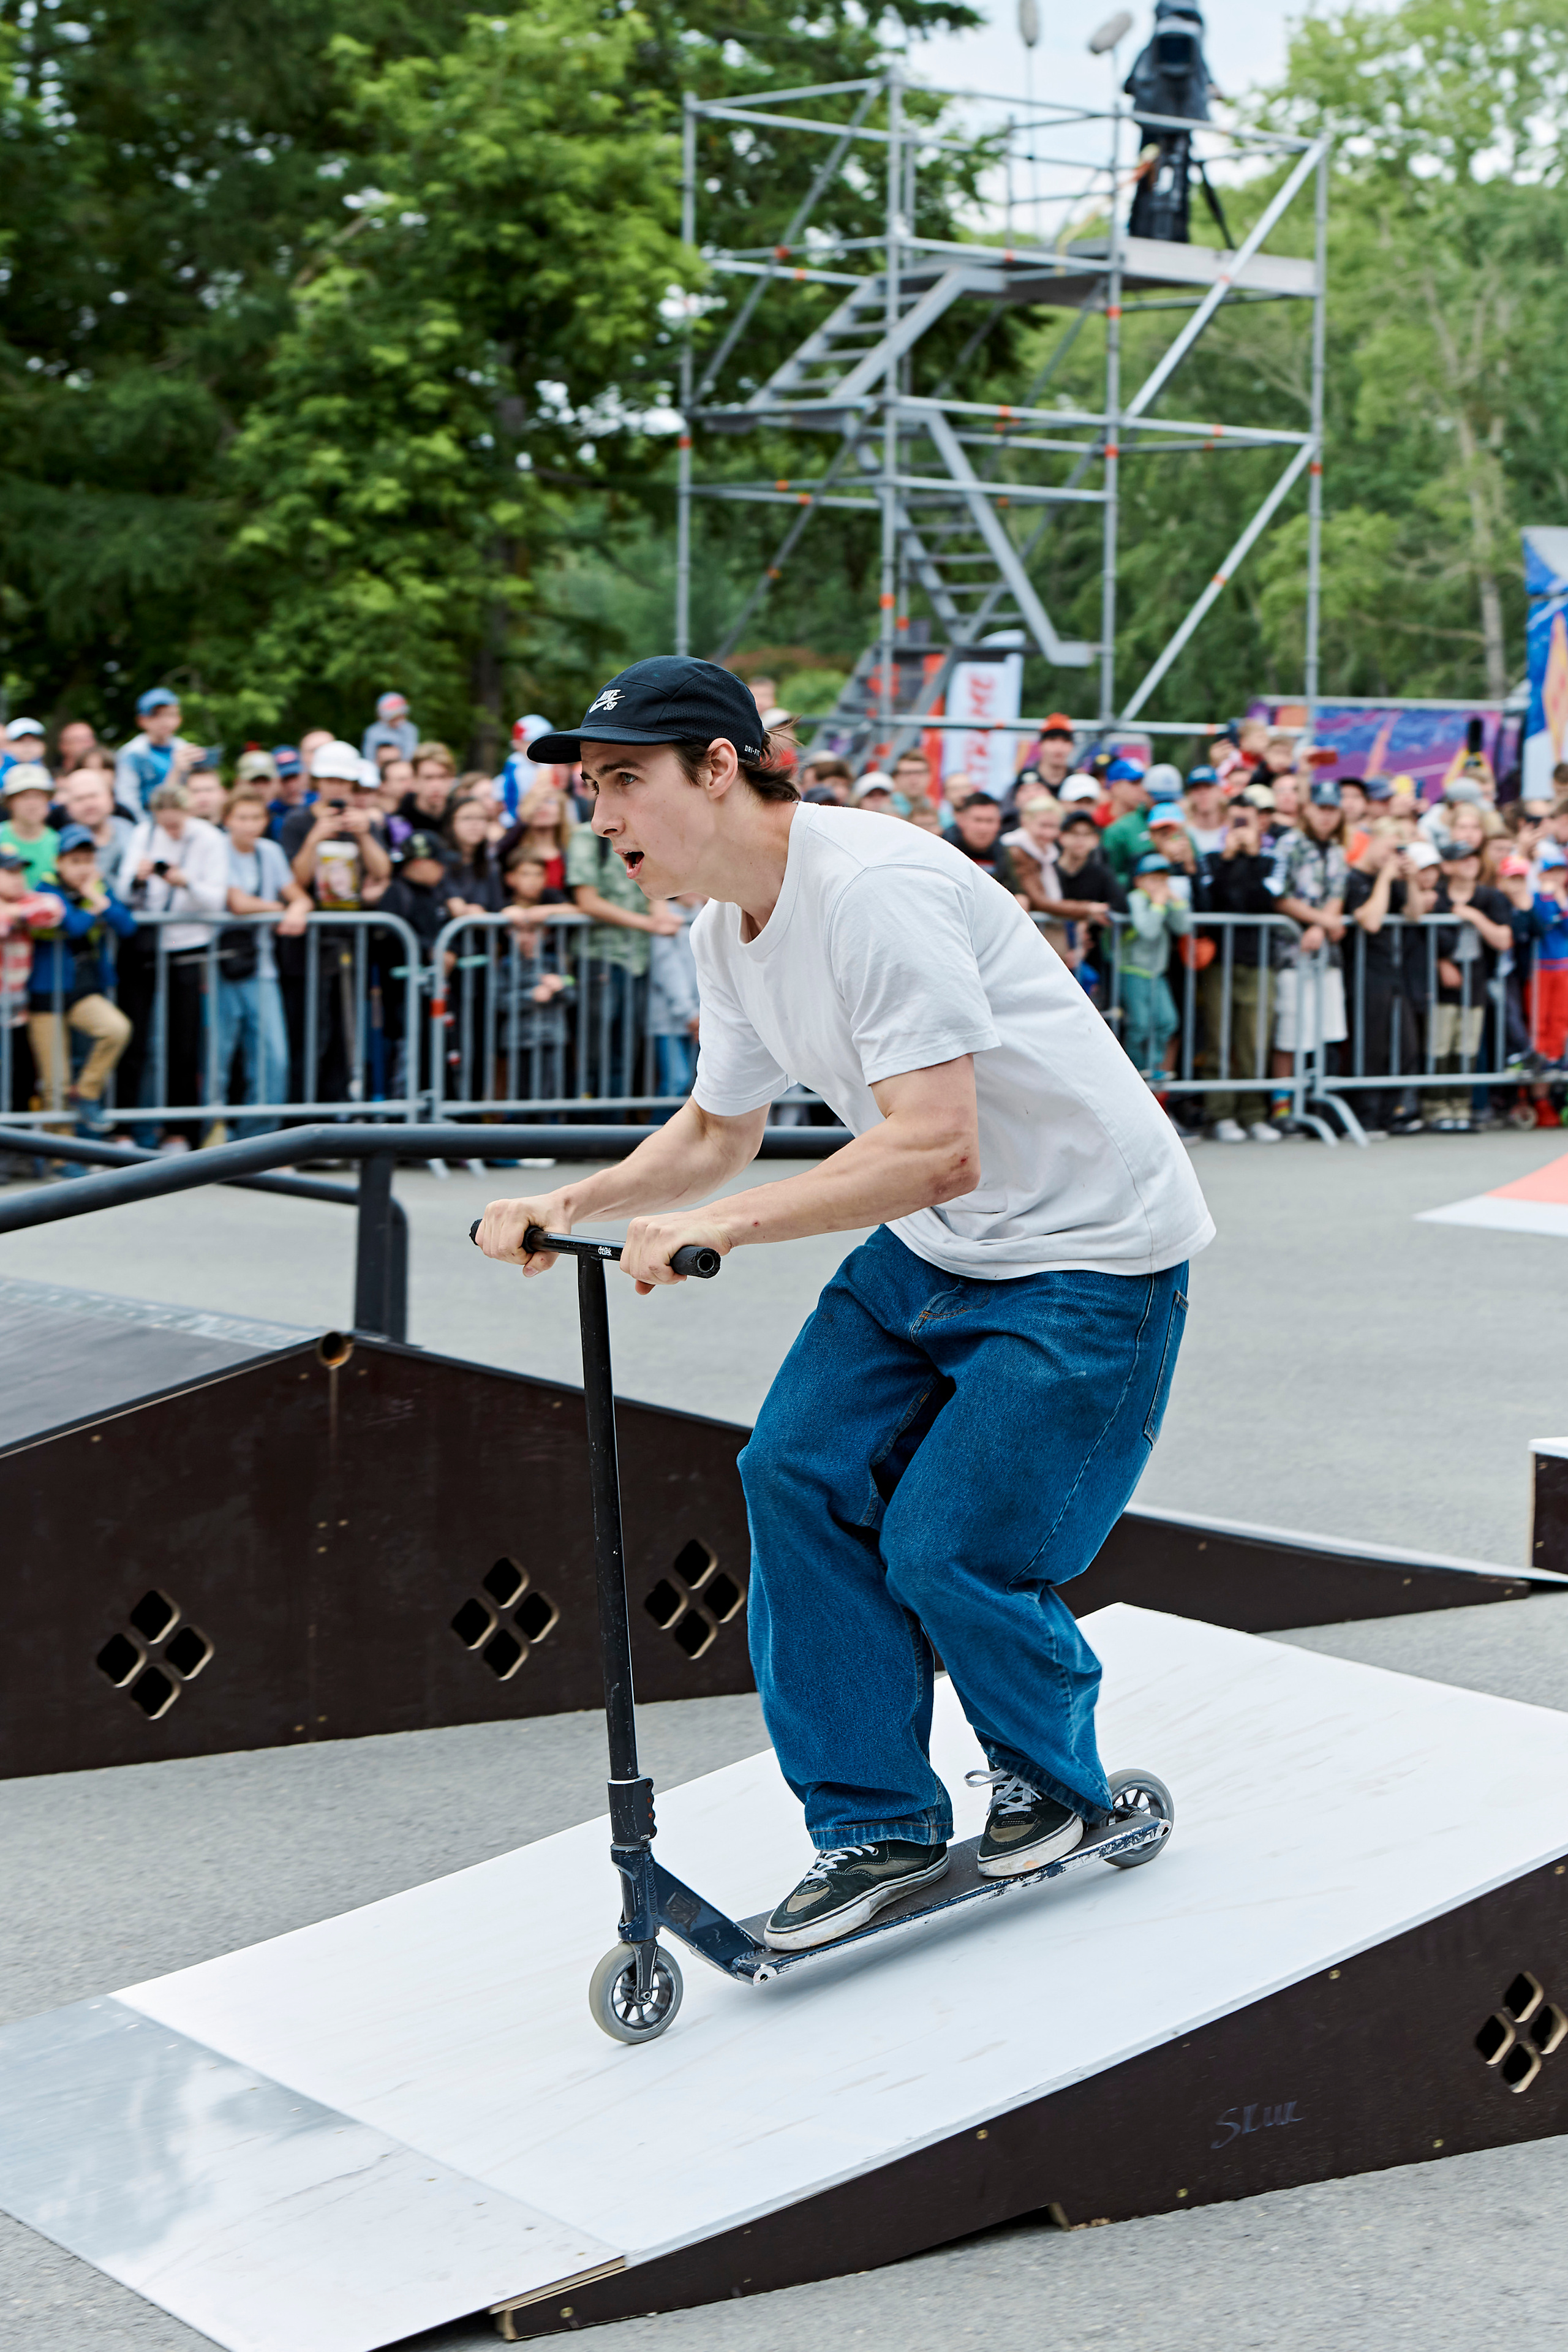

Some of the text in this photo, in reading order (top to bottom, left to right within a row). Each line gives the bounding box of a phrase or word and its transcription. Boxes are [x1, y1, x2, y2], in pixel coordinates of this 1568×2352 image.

[597, 689, 621, 702] NIKE
[603, 701, 618, 710] SB
[744, 745, 760, 756] DRI-FIT
